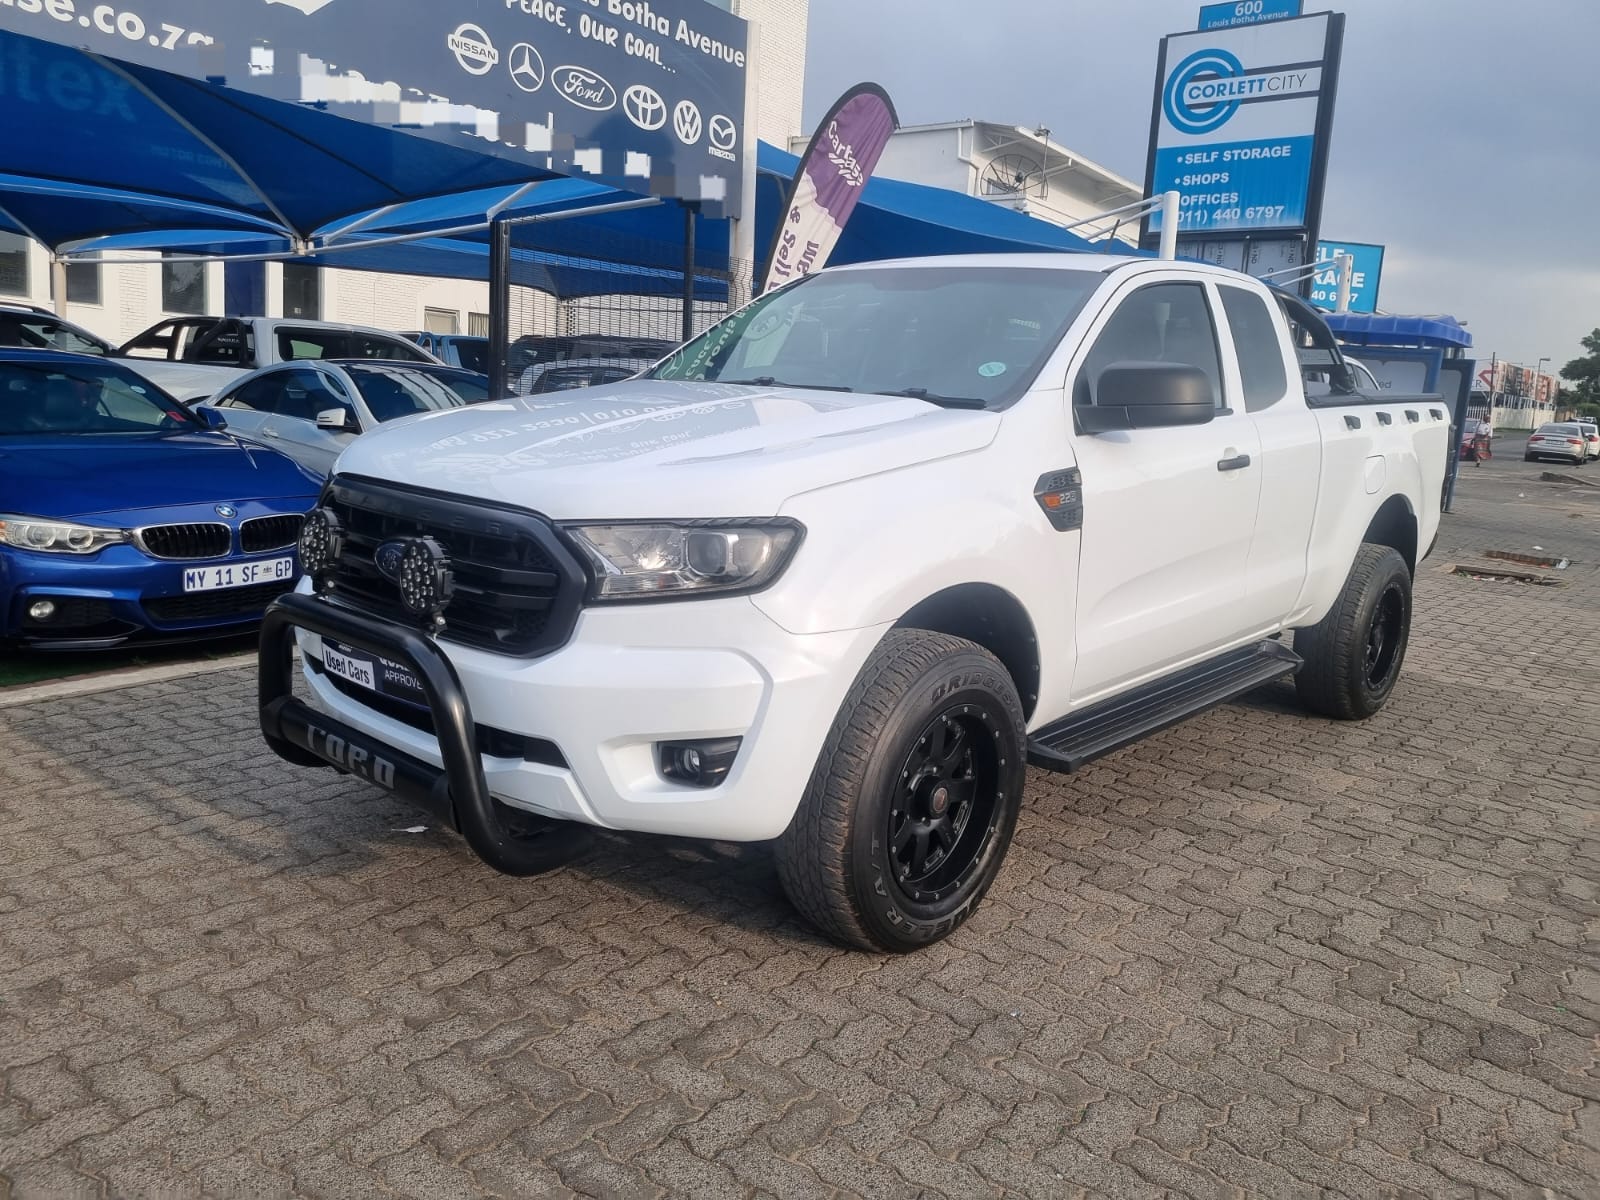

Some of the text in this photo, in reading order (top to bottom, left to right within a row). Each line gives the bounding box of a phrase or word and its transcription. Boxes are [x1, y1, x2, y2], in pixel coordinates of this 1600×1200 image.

[1235, 0, 1263, 16] 600
[579, 14, 619, 47] OUR
[1207, 11, 1289, 29] Louis Botha Avenue
[451, 38, 496, 61] NISSAN
[675, 19, 745, 68] Avenue
[563, 71, 606, 103] Ford
[1184, 145, 1292, 165] SELF STORAGE
[1182, 172, 1230, 186] SHOPS
[1180, 192, 1239, 207] OFFICES
[1212, 207, 1241, 220] 440
[1244, 206, 1285, 219] 6797
[774, 229, 797, 277] Sell
[1329, 291, 1359, 303] 67
[186, 559, 292, 590] MY 11 SF GP
[325, 649, 347, 675] Used
[347, 660, 371, 685] Cars
